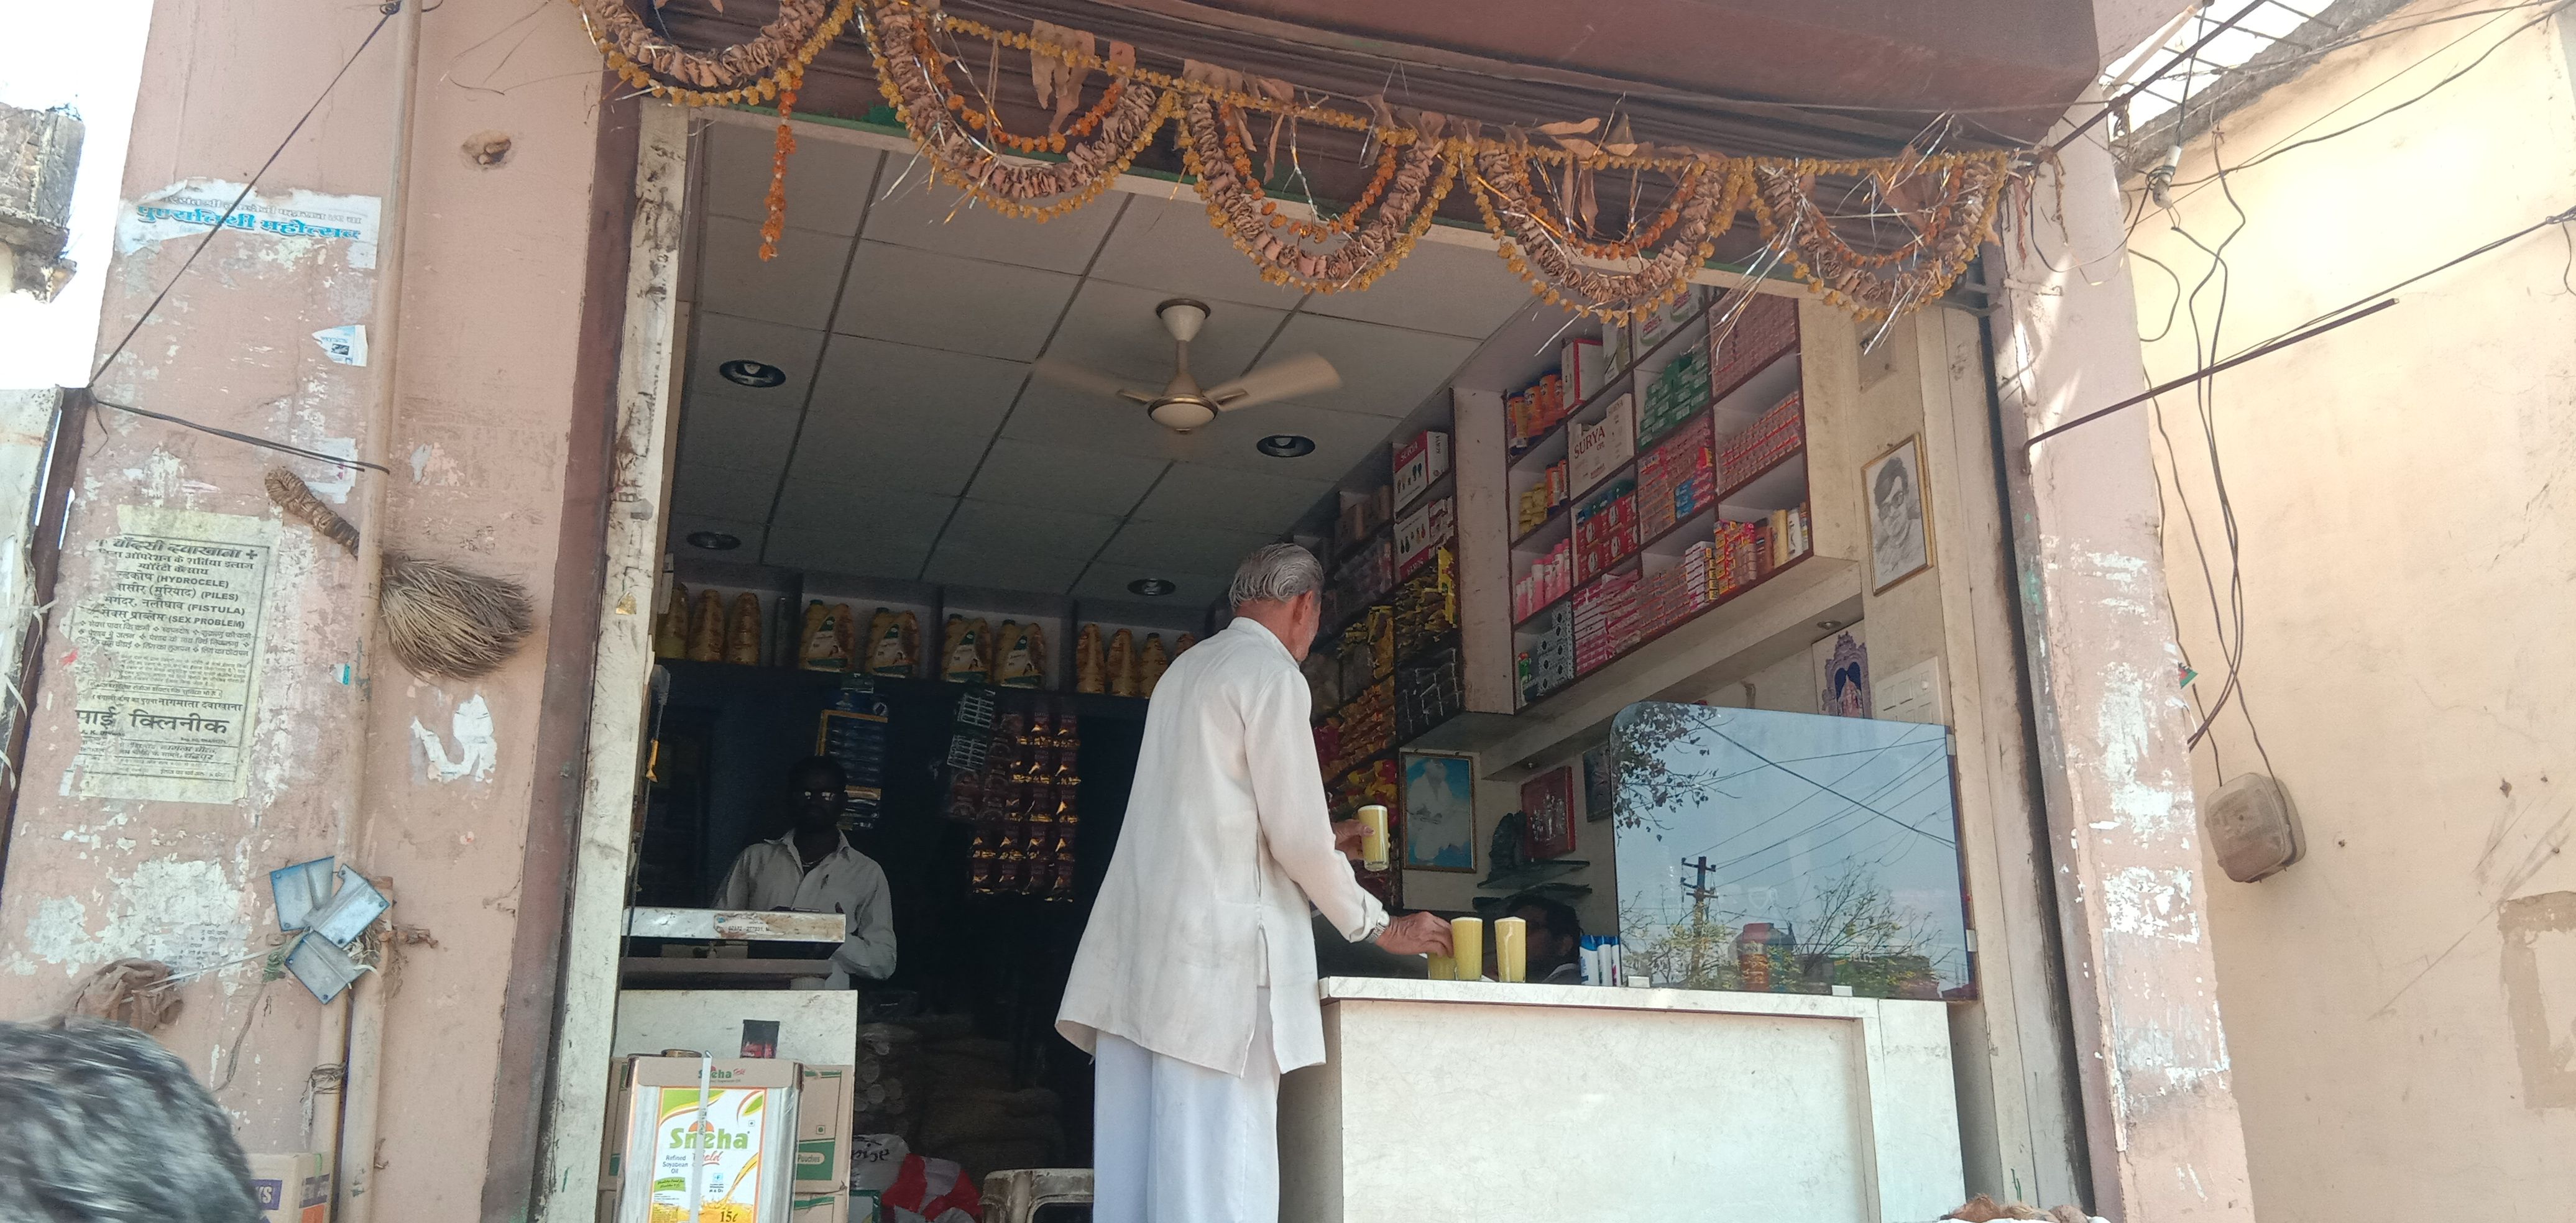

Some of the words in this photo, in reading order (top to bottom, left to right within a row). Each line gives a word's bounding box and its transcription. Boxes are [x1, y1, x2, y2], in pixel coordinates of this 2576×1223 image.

[1574, 426, 1605, 459] SURYA
[157, 575, 229, 589] (HYDROCELE)
[201, 591, 239, 602] (PILES)
[188, 603, 246, 616] (FISTULA)
[168, 615, 191, 624] (SEX
[193, 617, 246, 629] PROBLEM)
[159, 698, 201, 708] नागमाता
[201, 701, 244, 712] दवाखाना
[698, 1069, 732, 1079] Seha
[669, 1128, 748, 1149] Sneha
[797, 1154, 821, 1163] Pouches
